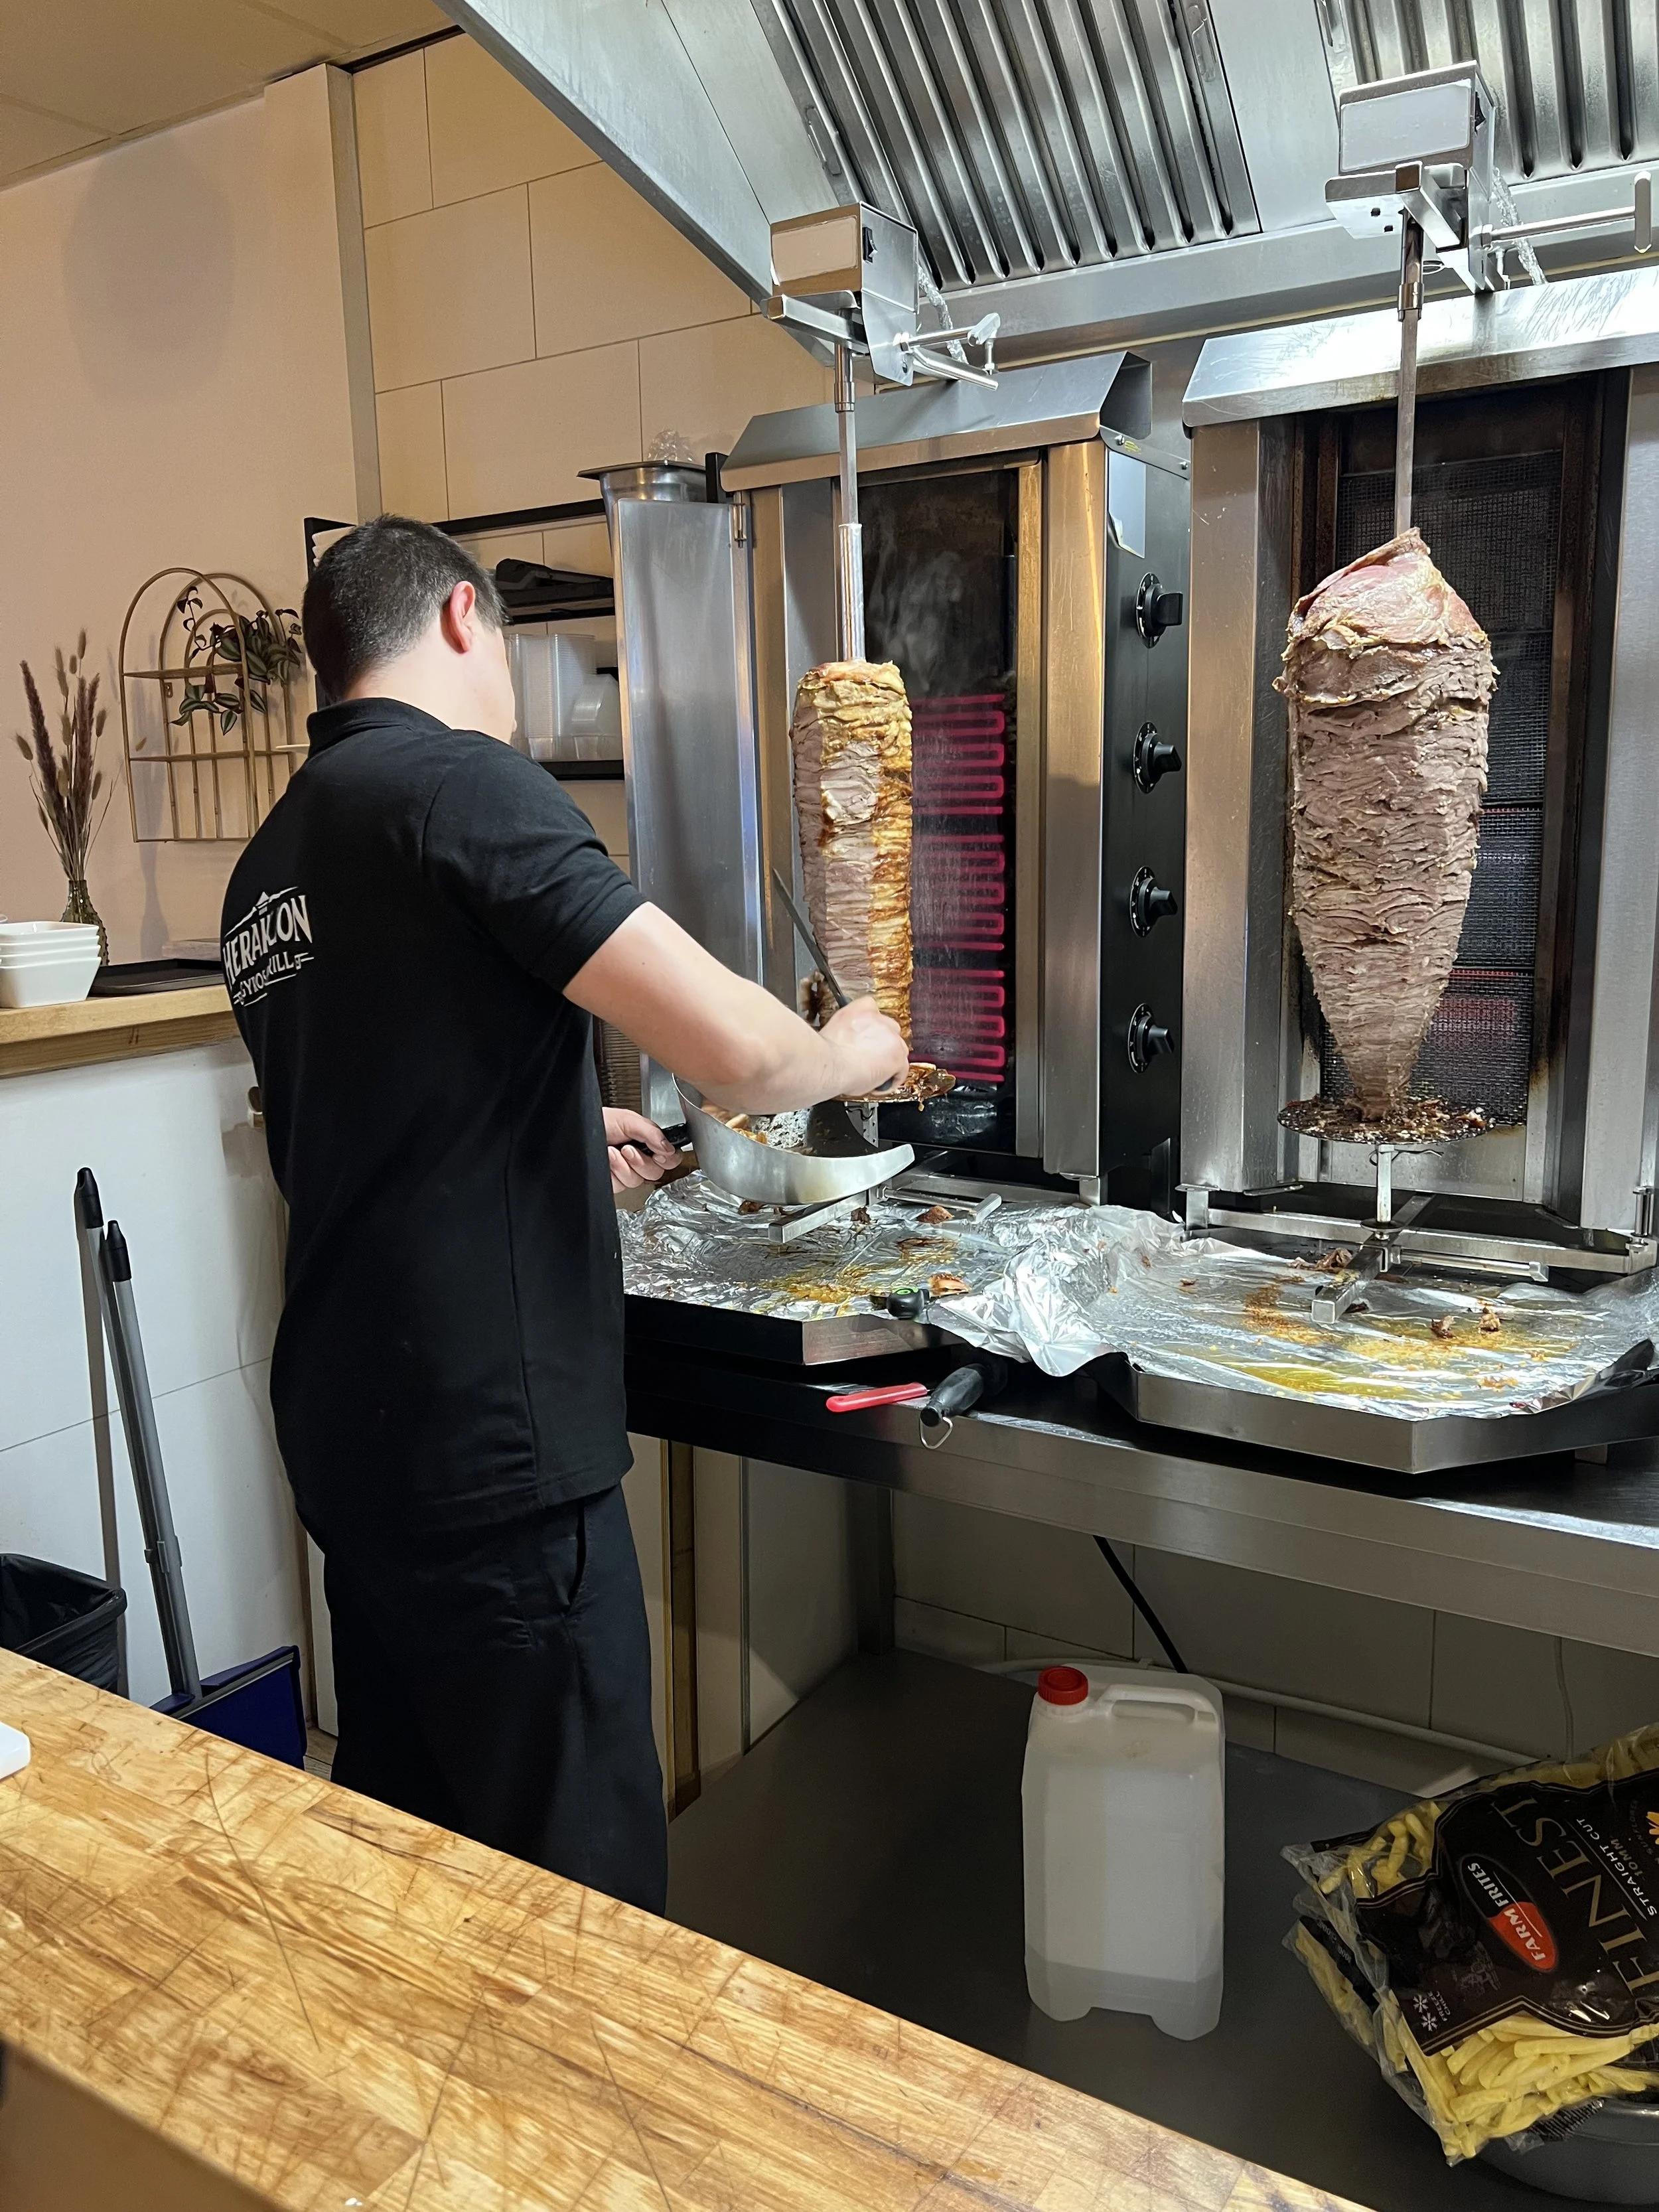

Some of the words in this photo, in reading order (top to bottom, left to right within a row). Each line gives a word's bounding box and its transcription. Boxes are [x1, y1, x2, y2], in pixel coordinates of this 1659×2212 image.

[1576, 1818, 1600, 1840] CUT
[1467, 1862, 1509, 1907] FRITES
[1489, 1796, 1659, 1997] FINEST
[1600, 1844, 1658, 1916] STRAIGHT
[1504, 1908, 1546, 1960] FARM
